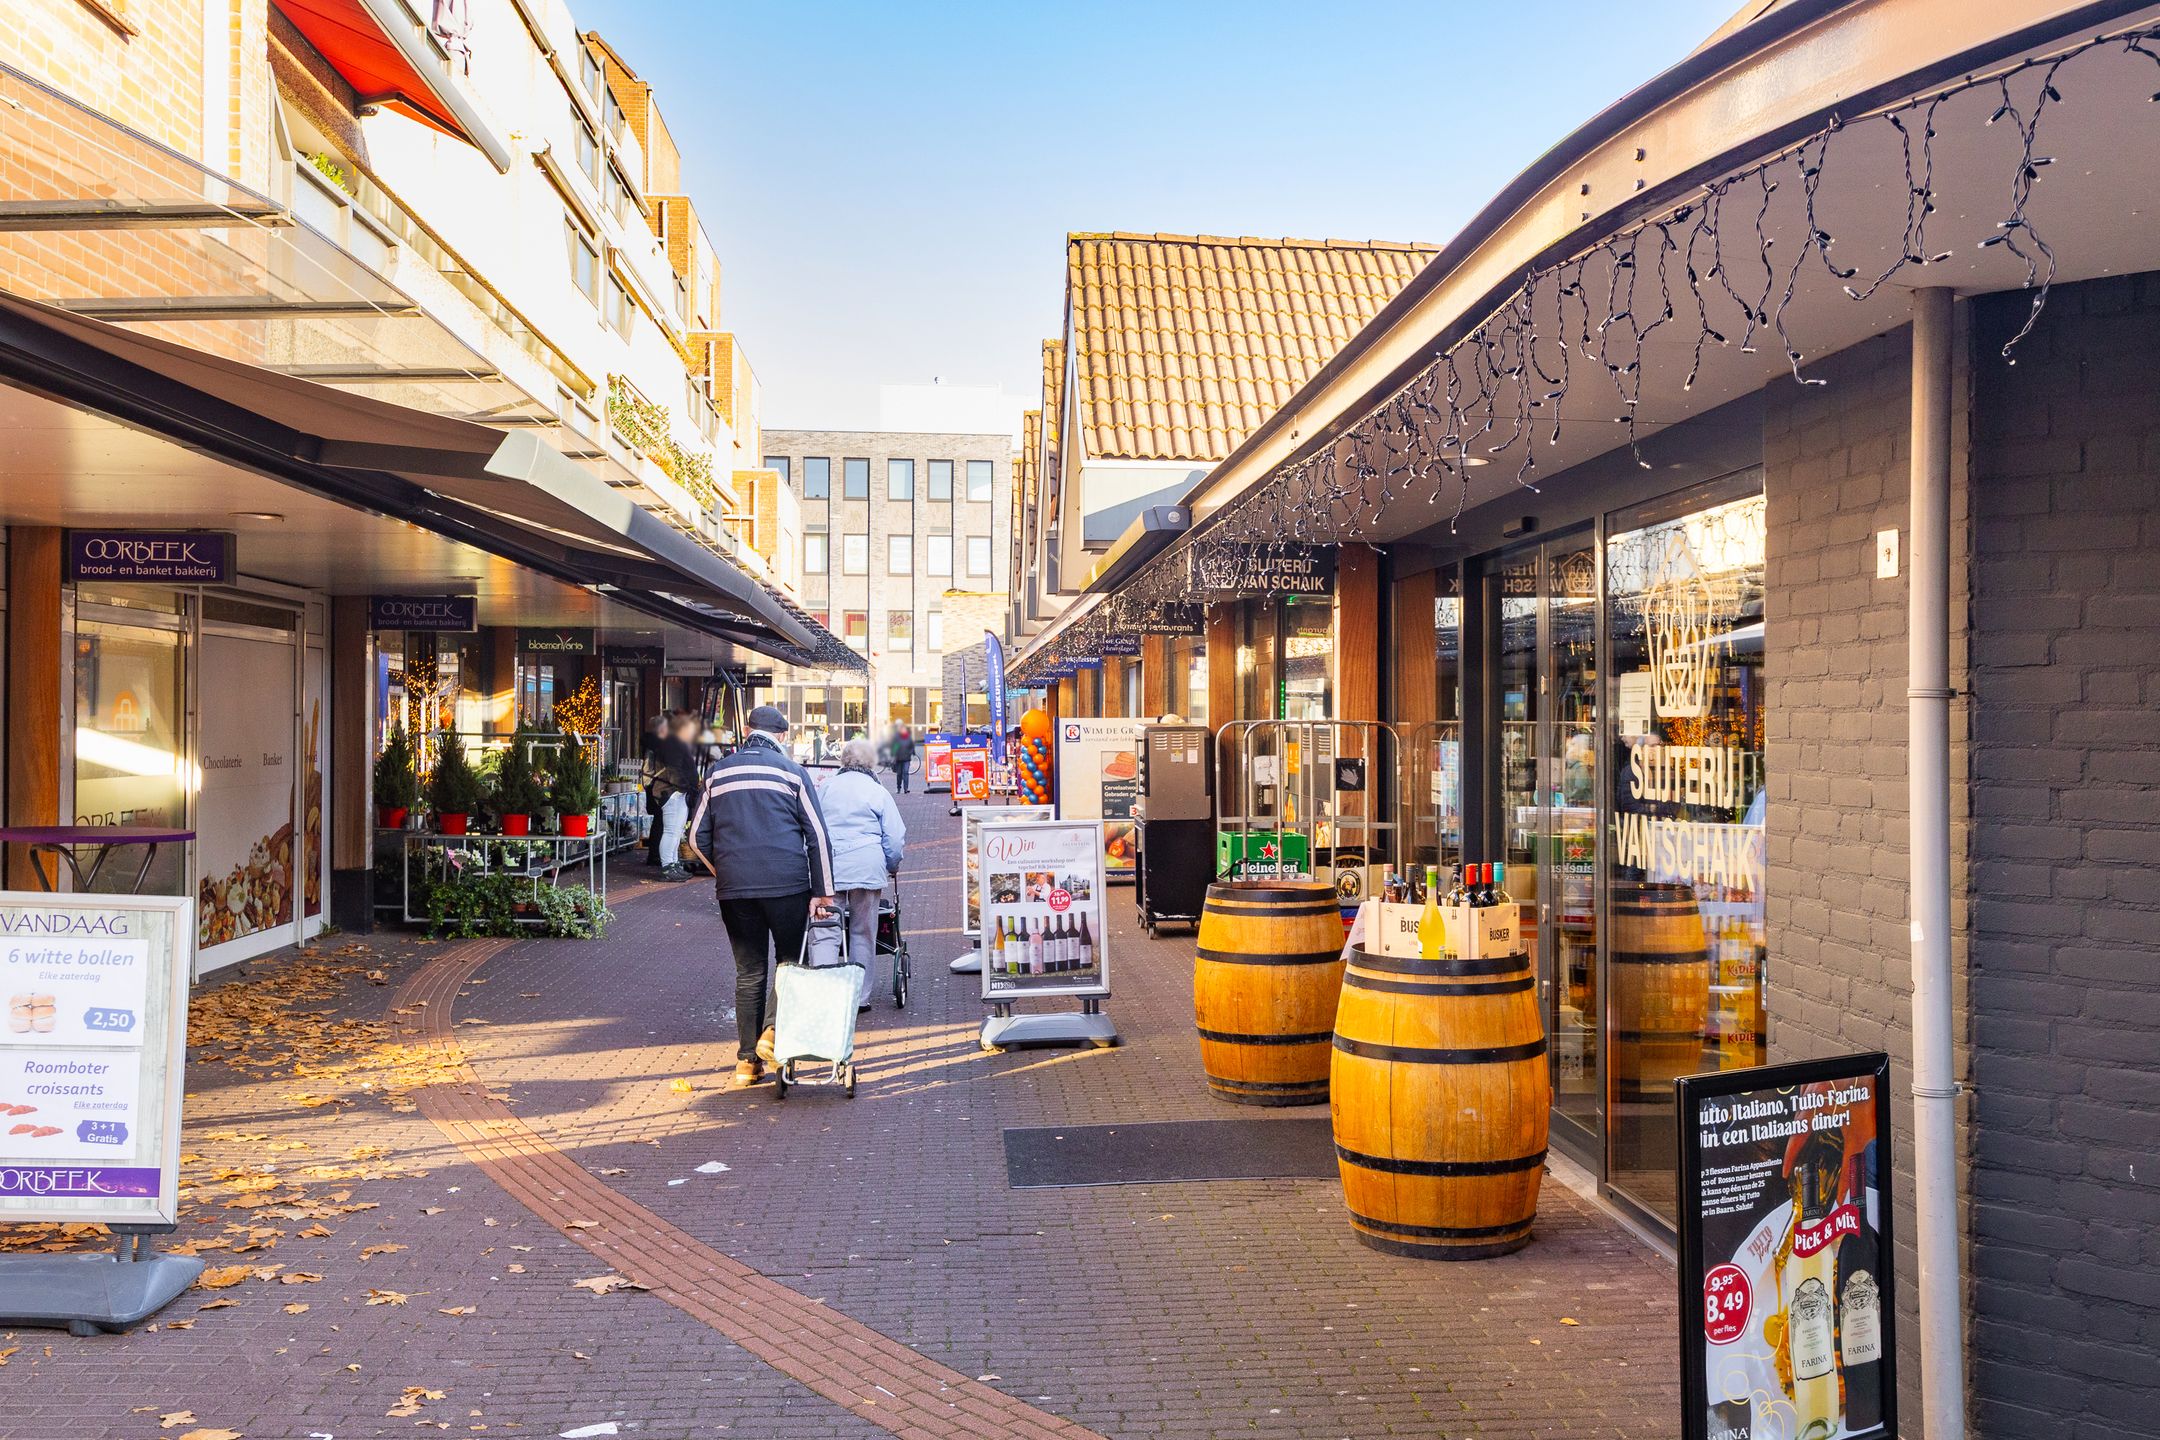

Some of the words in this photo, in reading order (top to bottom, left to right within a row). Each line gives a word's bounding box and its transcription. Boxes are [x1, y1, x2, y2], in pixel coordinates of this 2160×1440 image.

[85, 539, 211, 564] OORBEEK
[80, 564, 117, 575] brood-
[119, 567, 133, 575] en
[135, 565, 172, 576] banket
[175, 566, 217, 578] bakkerij
[1243, 574, 1268, 590] VAN
[1271, 576, 1325, 591] SCHAIK
[381, 601, 462, 619] OORBEEK
[440, 618, 467, 628] bakkerij
[1083, 727, 1103, 735] WIM
[1106, 727, 1118, 735] DE
[1120, 726, 1134, 735] GR
[203, 754, 243, 770] Chocolaterie
[263, 752, 283, 766] Banket
[1629, 743, 1734, 810] SLIJTERIJ
[986, 835, 1036, 861] Win
[1614, 811, 1656, 872] VAN
[1661, 817, 1756, 893] SCHAIK
[0, 913, 128, 935] VANDAAG
[1400, 919, 1420, 933] BUS
[1489, 927, 1510, 941] BUSKER
[8, 948, 21, 964] 6
[25, 948, 73, 965] witte
[78, 949, 135, 966] bollen
[39, 971, 59, 980] Elke
[60, 972, 101, 983] zaterdag
[92, 1011, 130, 1028] 2,50
[24, 1061, 110, 1075] Roomboter
[27, 1082, 104, 1096] croissants
[73, 1101, 92, 1110] Elke
[93, 1101, 129, 1111] zaterdag
[1700, 1105, 1729, 1125] utto
[1732, 1100, 1789, 1121] Italiano,
[1790, 1093, 1825, 1111] Tutto
[1827, 1086, 1871, 1107] Farina
[91, 1122, 98, 1131] 3
[110, 1123, 115, 1131] 1
[1700, 1129, 1720, 1149] in
[1722, 1126, 1749, 1147] een
[1751, 1118, 1809, 1142] Italiaans
[1811, 1110, 1851, 1131] diner!
[87, 1133, 119, 1144] Gratis
[1710, 1167, 1731, 1175] flessen
[1731, 1164, 1750, 1173] Farina
[0, 1168, 118, 1195] ORBEEK
[1710, 1177, 1717, 1185] of
[1718, 1176, 1736, 1184] Rosso
[1722, 1187, 1730, 1195] op
[1742, 1183, 1752, 1191] van
[1758, 1180, 1766, 1188] 25
[1720, 1196, 1738, 1204] diners
[1746, 1191, 1760, 1200] Tutto
[1709, 1207, 1716, 1215] in
[1716, 1206, 1736, 1214] Baarn.
[1736, 1202, 1754, 1212] Salute!
[1794, 1231, 1822, 1250] Pick
[1824, 1222, 1833, 1240] &
[1835, 1211, 1859, 1232] Mix
[1711, 1274, 1733, 1291] 9.95
[1706, 1290, 1744, 1323] 8.49
[1713, 1326, 1724, 1335] per
[1724, 1324, 1737, 1333] fles
[1848, 1343, 1876, 1355] FARINA
[1801, 1354, 1827, 1368] FARINA
